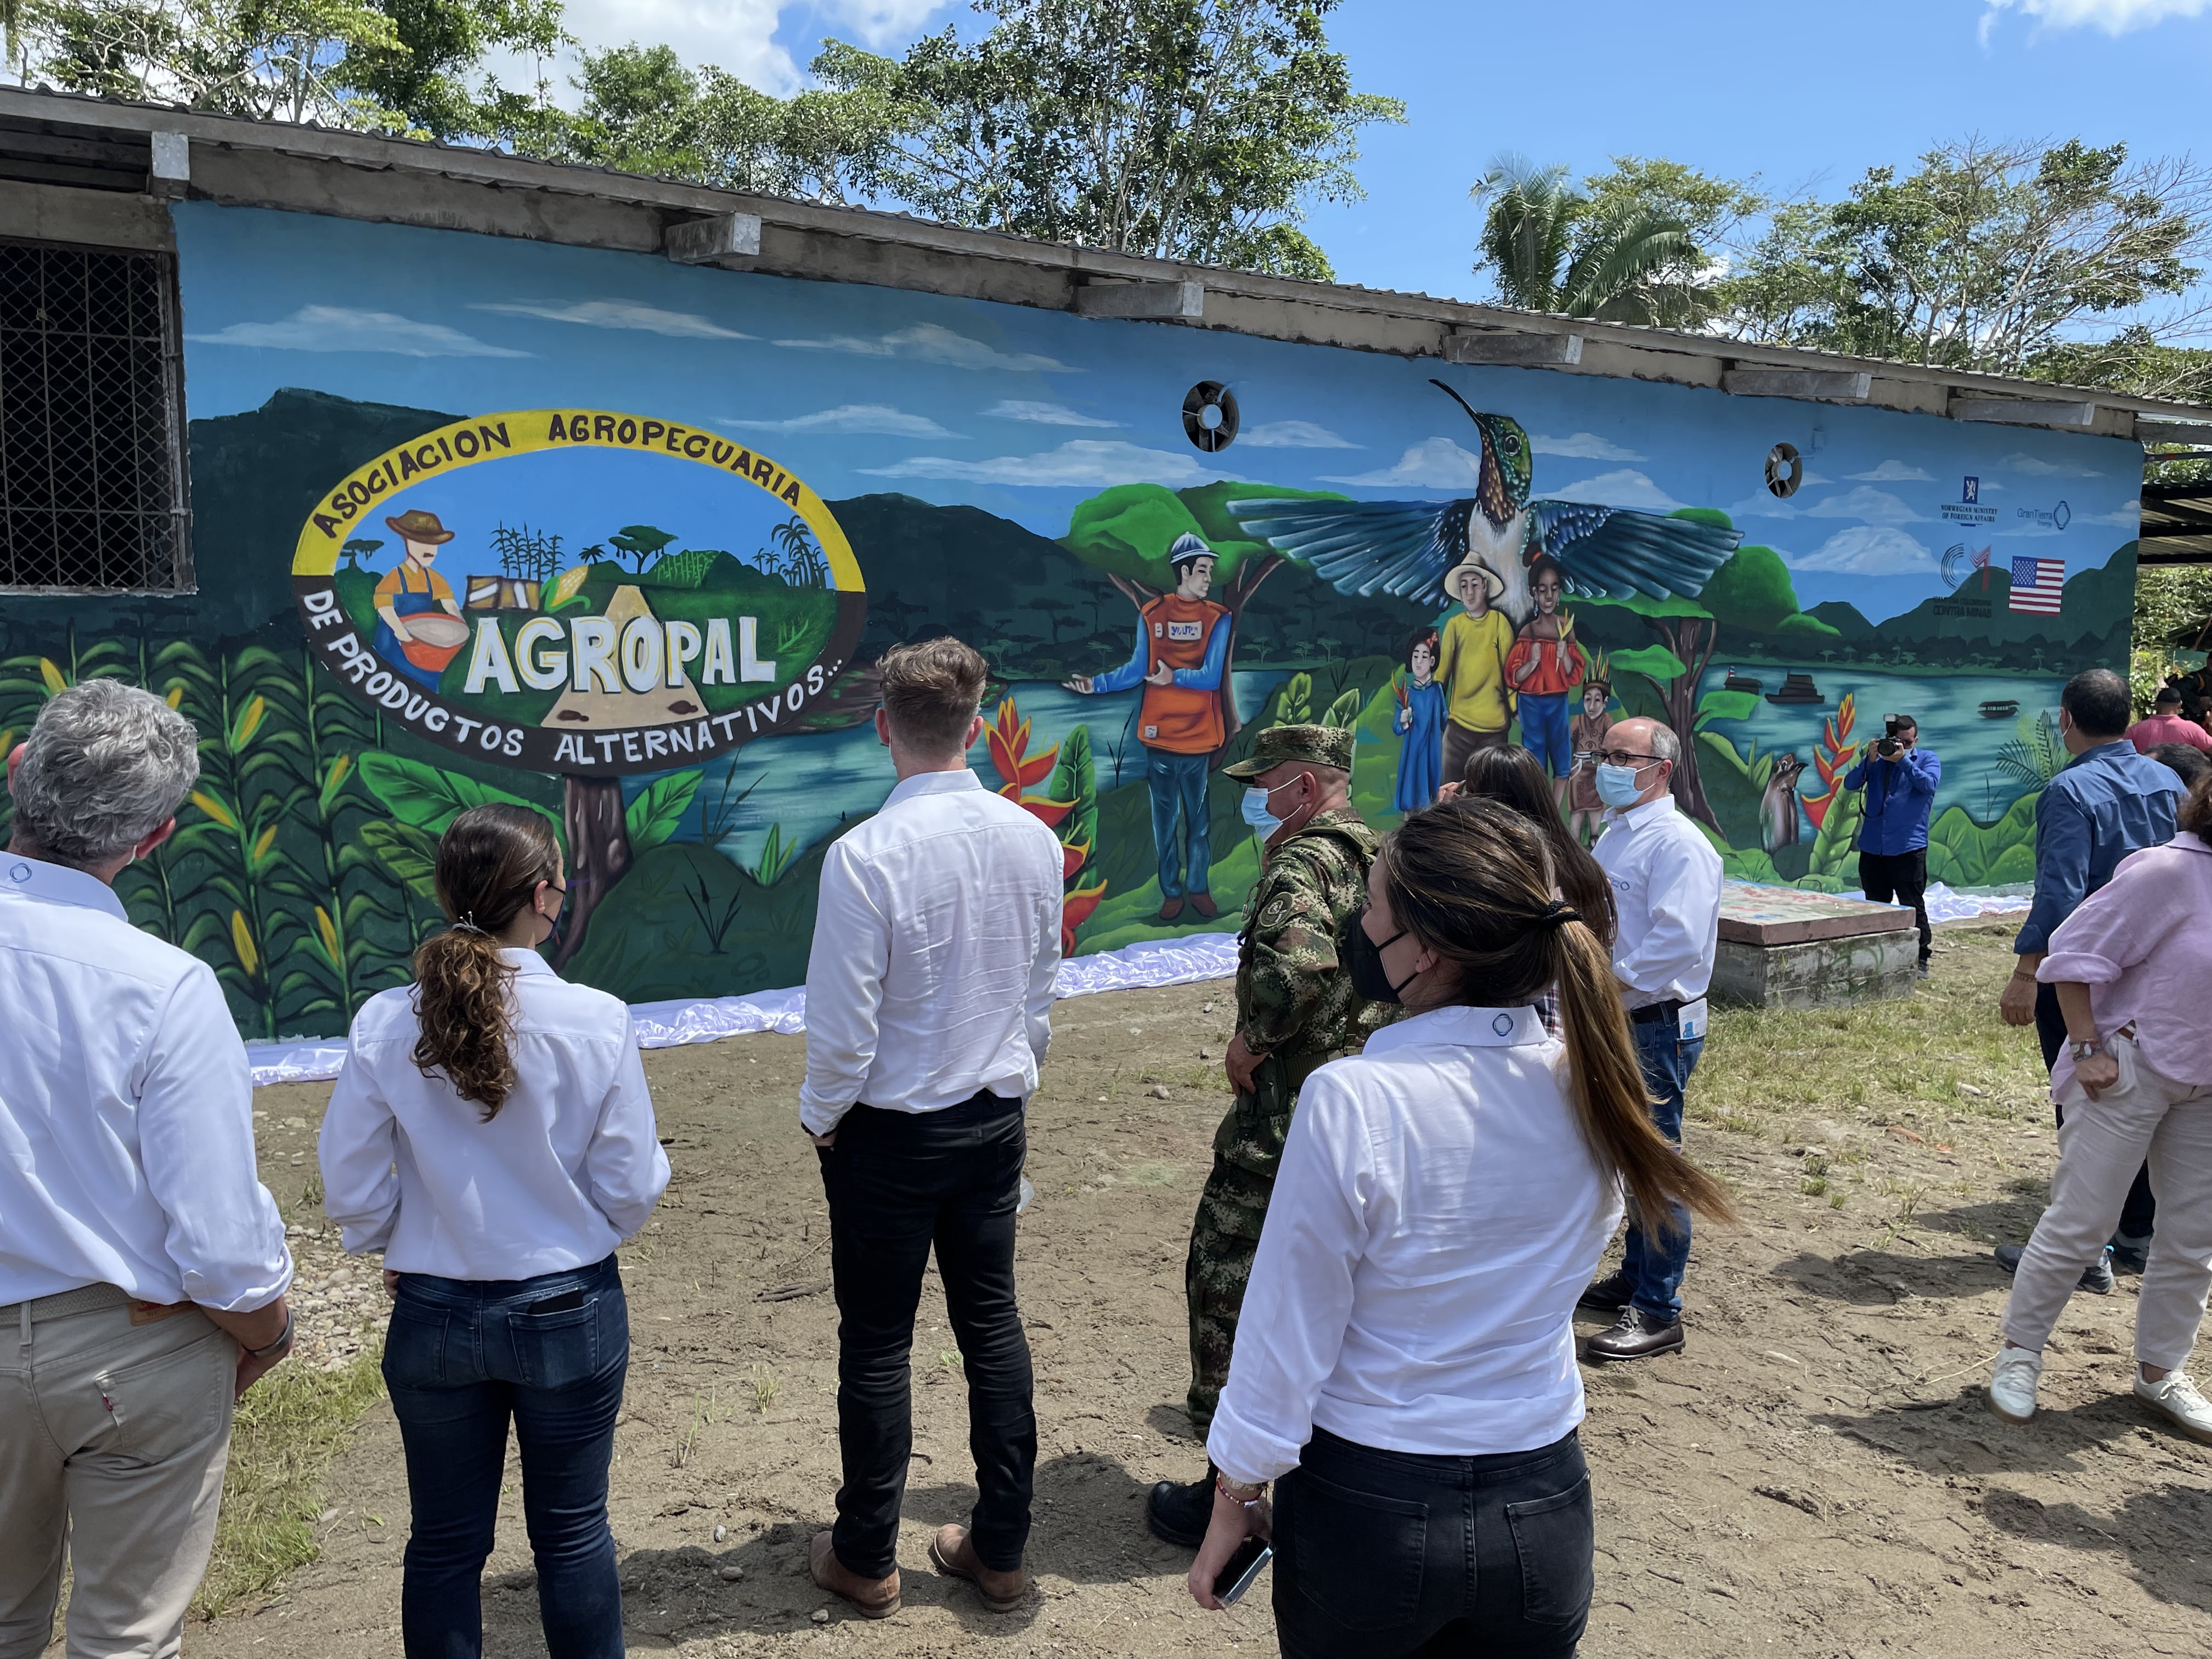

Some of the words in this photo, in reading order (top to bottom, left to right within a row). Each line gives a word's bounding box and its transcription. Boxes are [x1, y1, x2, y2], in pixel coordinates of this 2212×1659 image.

[313, 422, 511, 539] ASOCIACION
[549, 414, 801, 506] AGROPECUARIA
[1941, 504, 1972, 514] NORWEGIAN
[303, 589, 344, 631] DE
[327, 632, 525, 757] PRODUCTOS
[464, 616, 776, 694] AGROPAL
